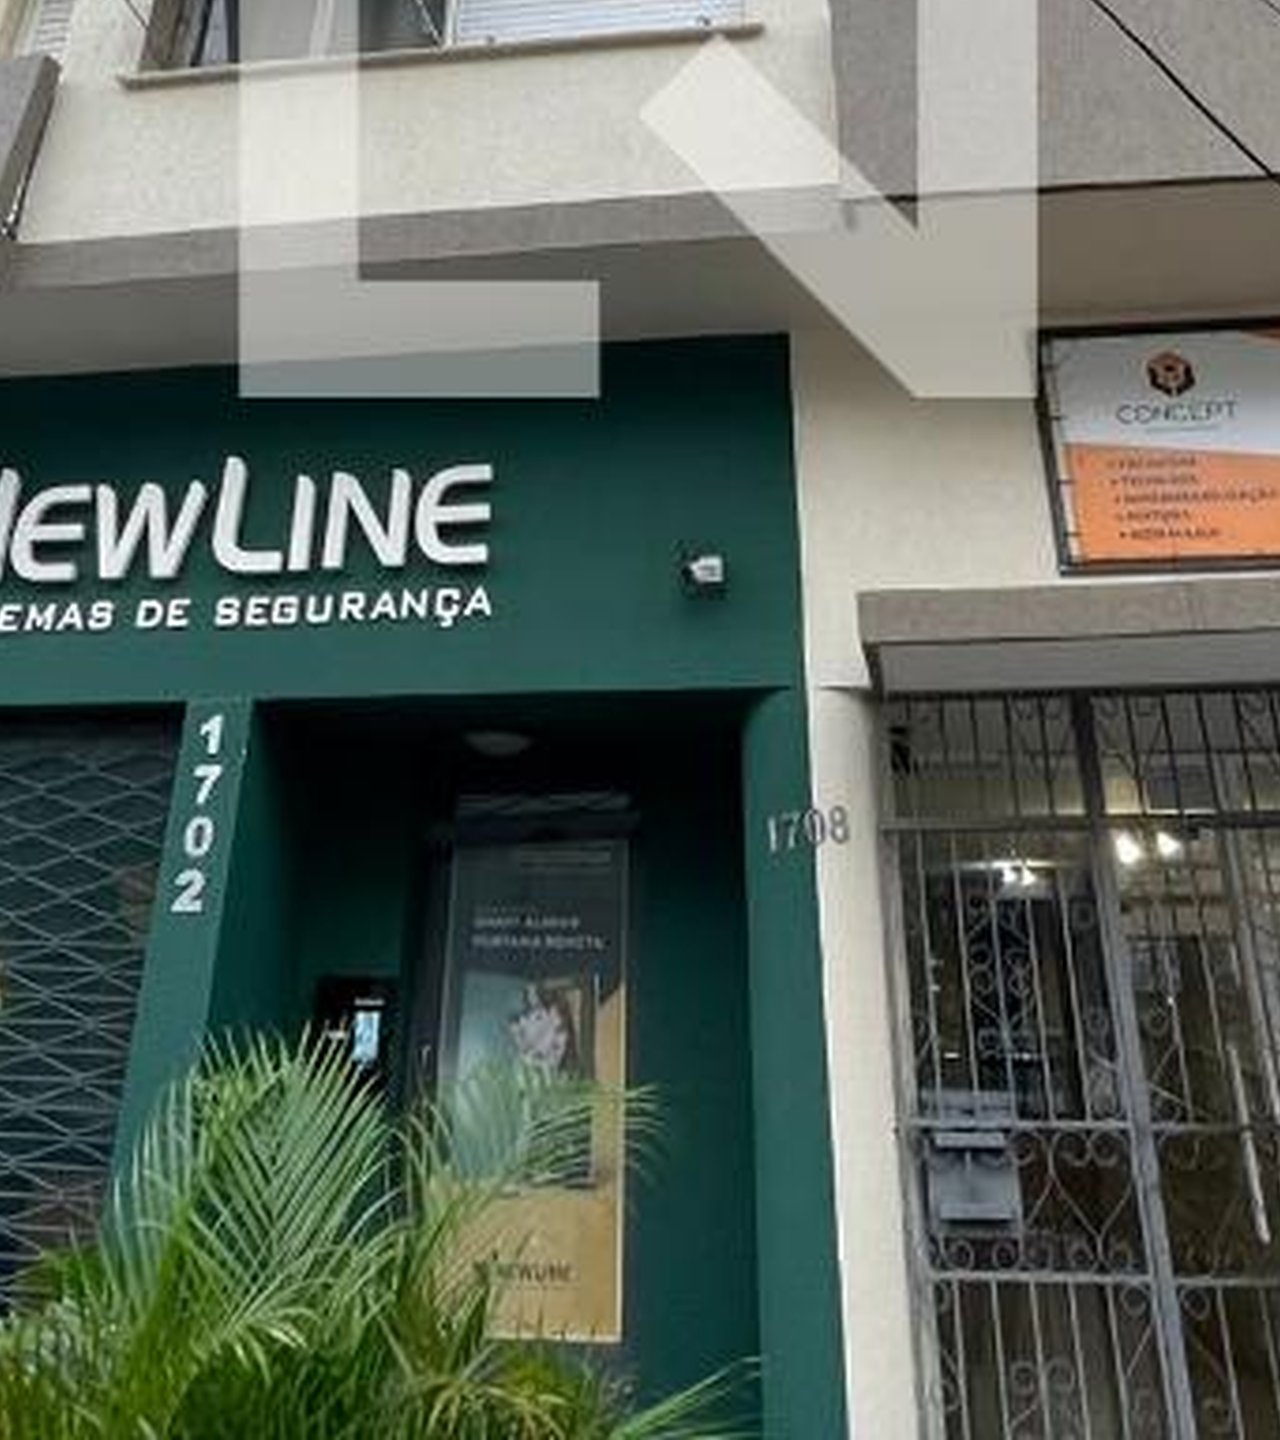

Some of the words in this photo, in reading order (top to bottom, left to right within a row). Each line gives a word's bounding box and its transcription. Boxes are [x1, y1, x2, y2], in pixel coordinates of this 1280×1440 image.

[1116, 401, 1237, 426] CONCEPT
[135, 597, 191, 627] DE
[214, 586, 493, 630] SEGURANÇA
[171, 715, 224, 913] 1702
[766, 805, 851, 853] 1708
